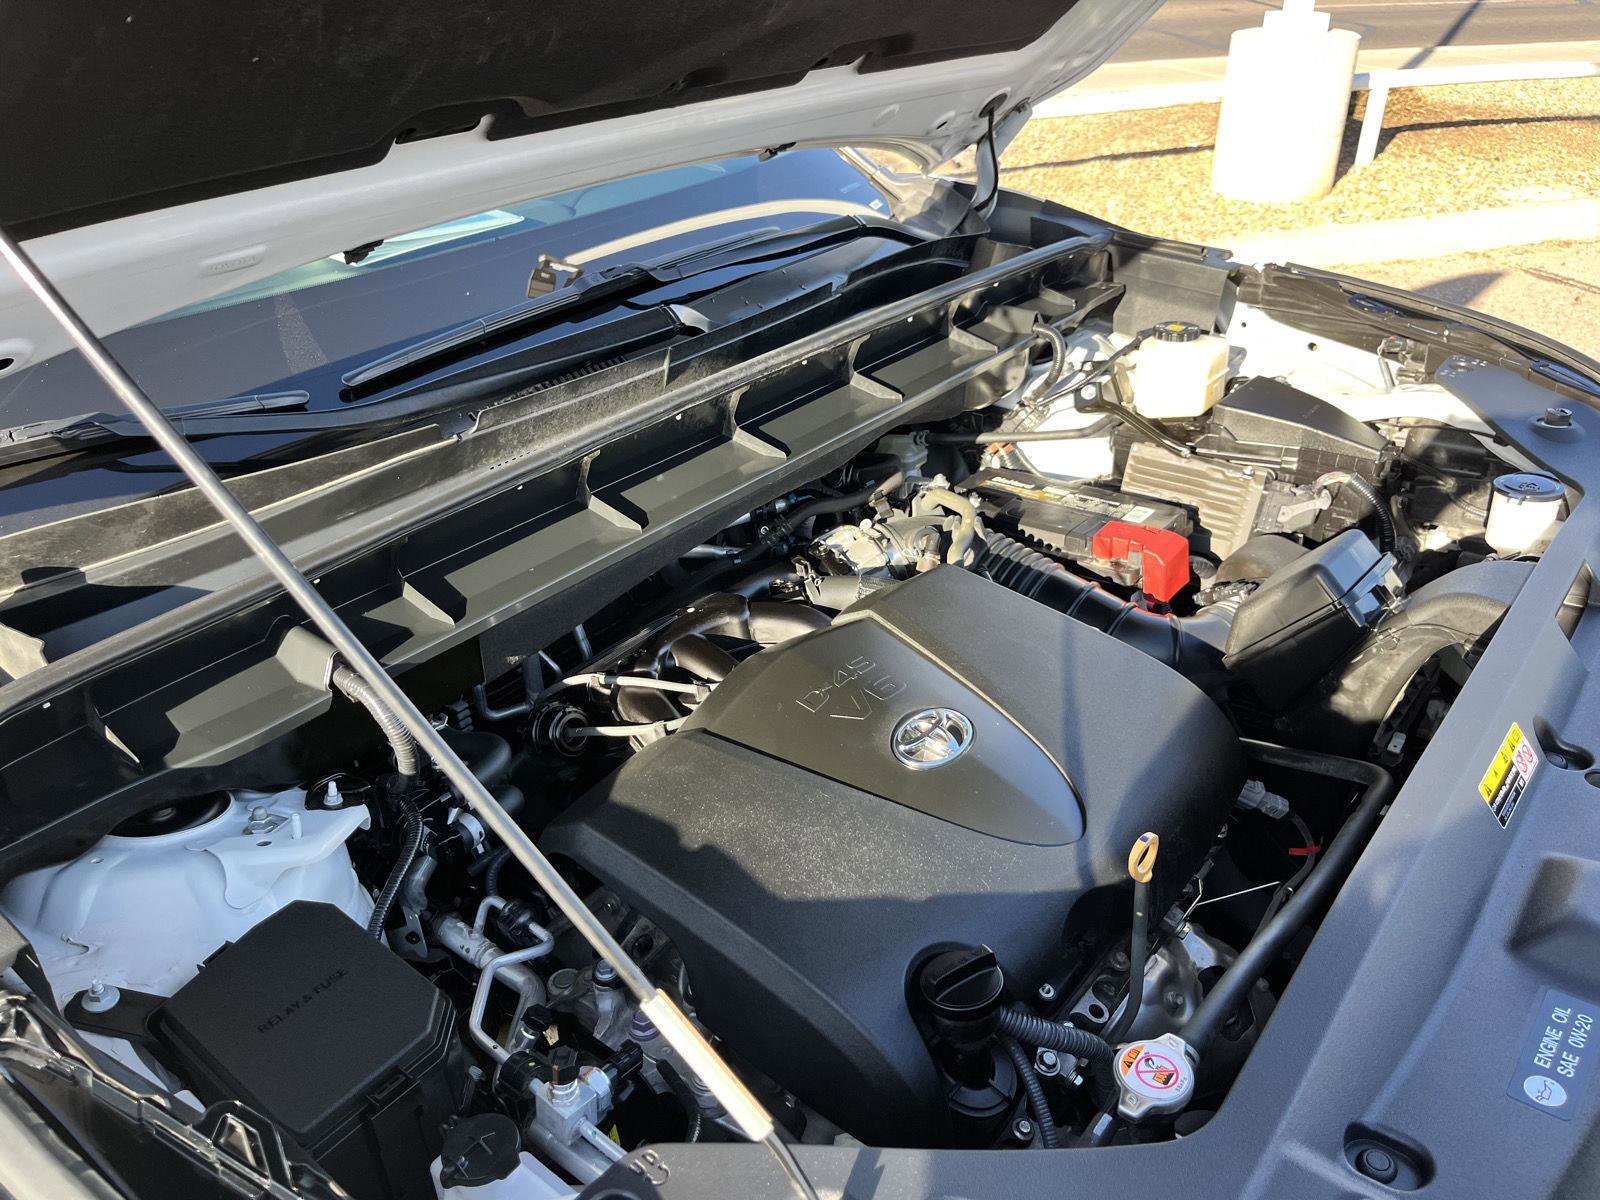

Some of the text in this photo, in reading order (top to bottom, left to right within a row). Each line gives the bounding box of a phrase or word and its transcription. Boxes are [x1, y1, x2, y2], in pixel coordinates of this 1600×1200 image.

[795, 655, 876, 713] D-4S
[829, 674, 908, 720] V6
[257, 1000, 300, 1034] RELAY
[312, 968, 349, 994] FUSE
[1533, 1006, 1572, 1069] ENGINE OIL
[1556, 1013, 1594, 1078] SAE 0W-20
